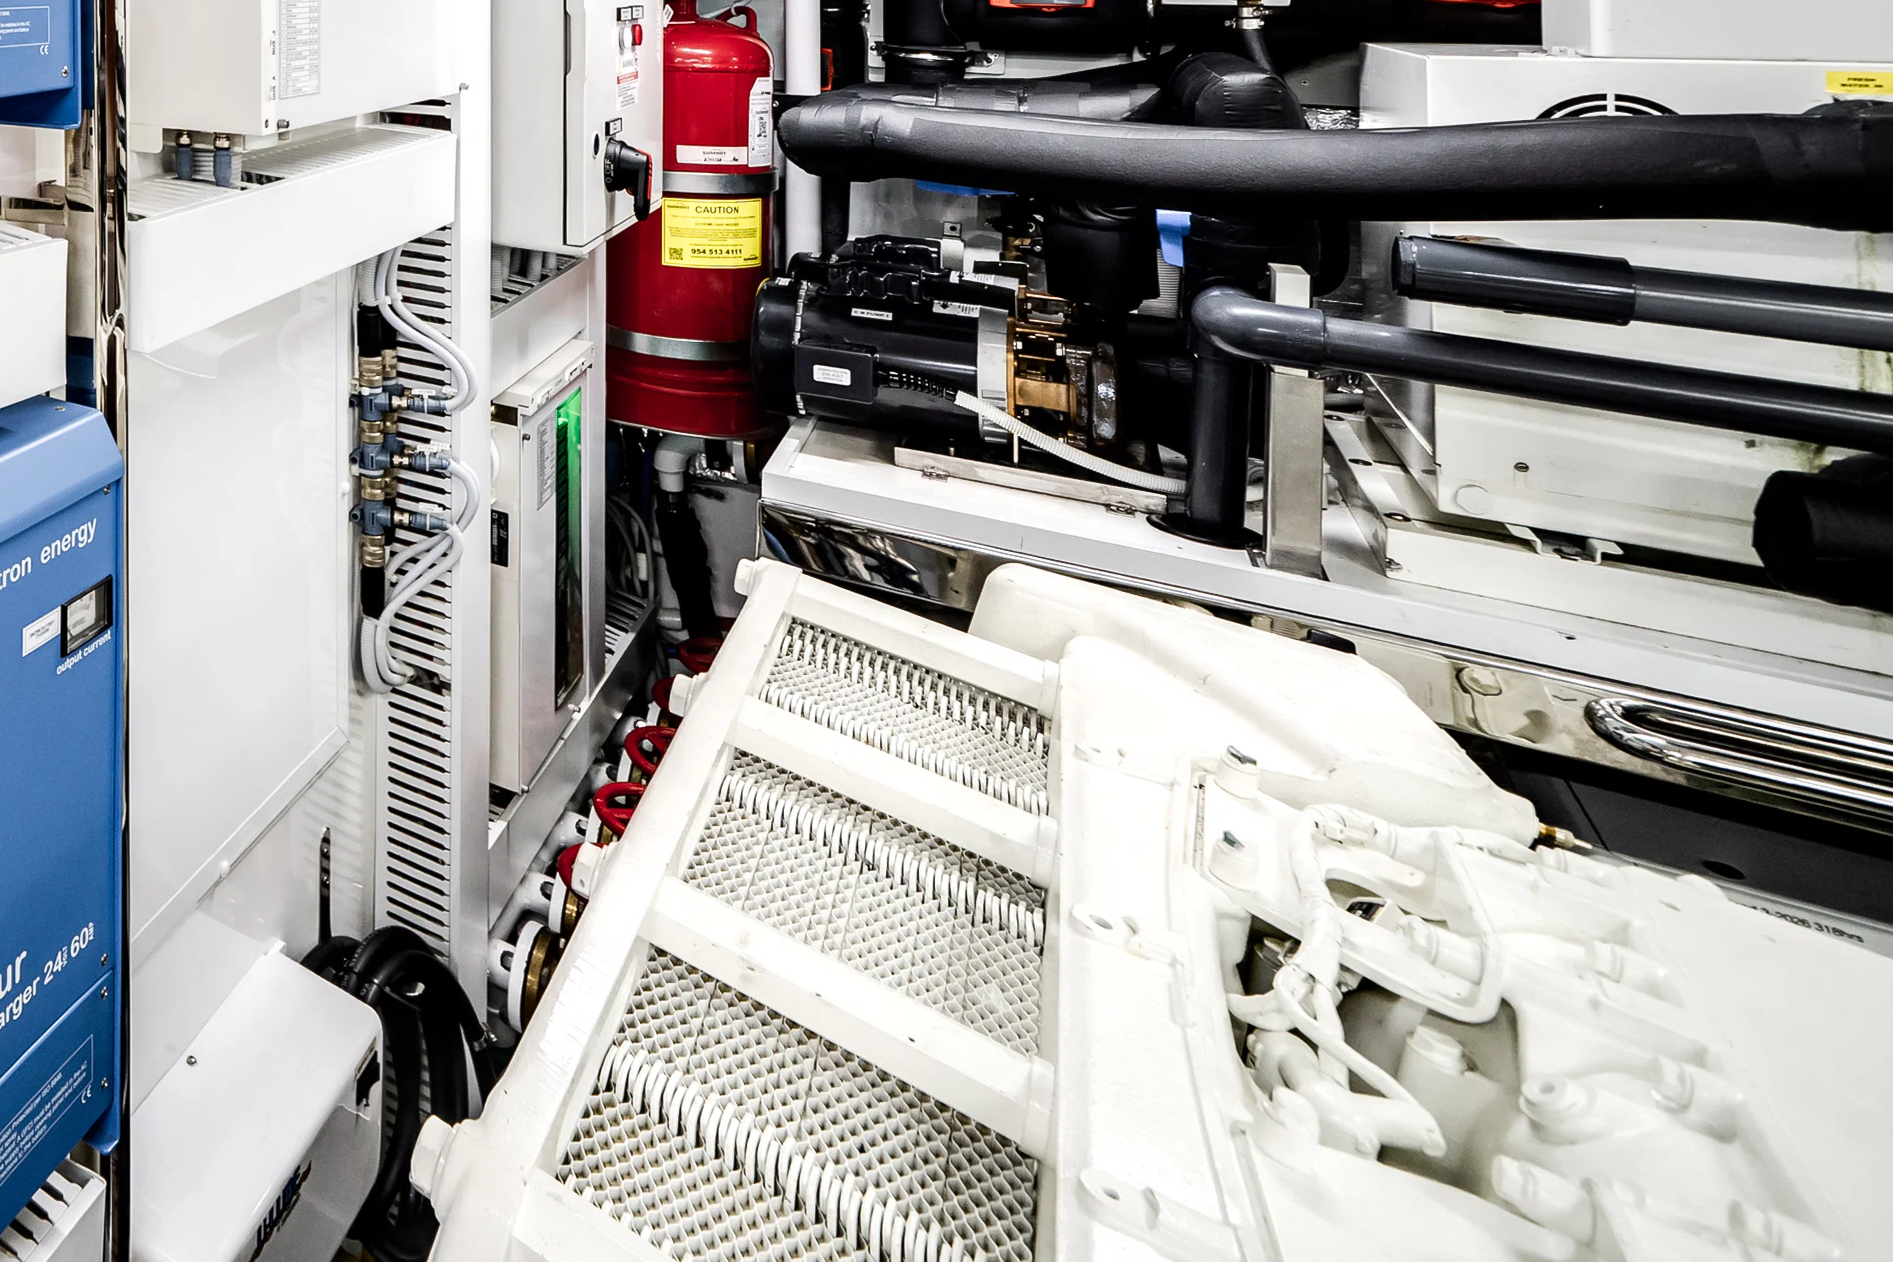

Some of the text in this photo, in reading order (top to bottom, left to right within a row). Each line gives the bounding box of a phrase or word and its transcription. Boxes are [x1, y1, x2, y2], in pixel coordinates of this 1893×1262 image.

[695, 205, 740, 214] CAUTION
[40, 517, 97, 565] energy
[56, 630, 112, 676] output current
[43, 950, 63, 986] 24
[70, 925, 89, 958] 60
